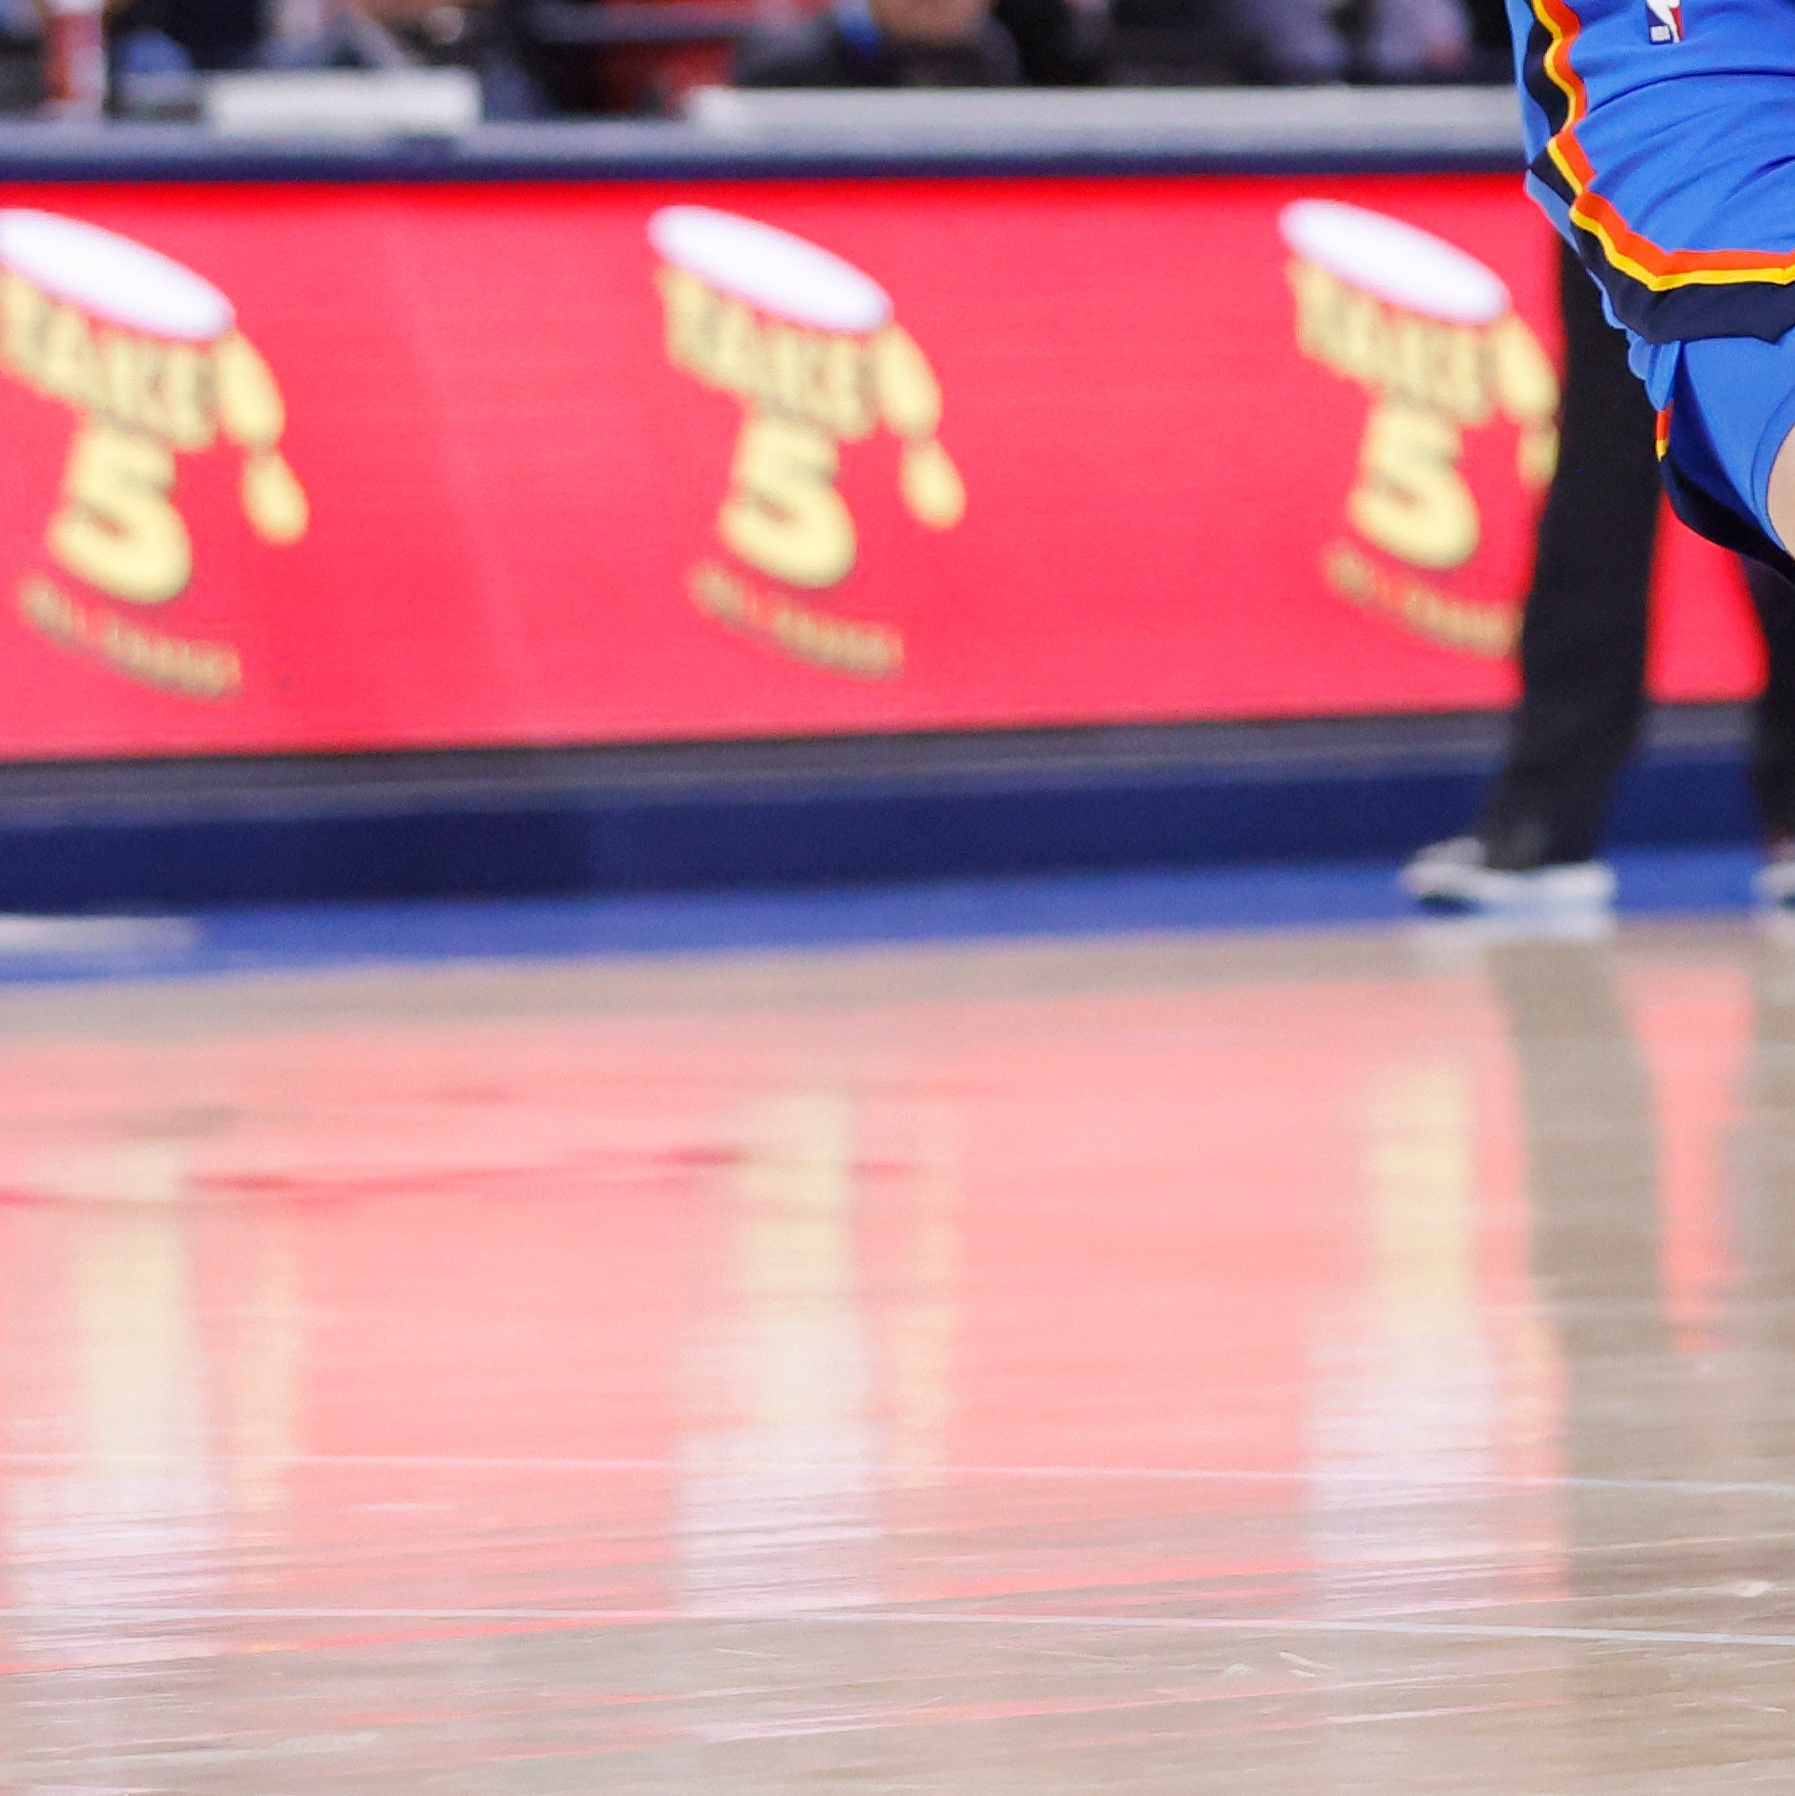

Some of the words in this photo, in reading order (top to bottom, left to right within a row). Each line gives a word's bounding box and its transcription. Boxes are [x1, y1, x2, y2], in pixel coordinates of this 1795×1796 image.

[45, 410, 194, 606] 5
[716, 401, 858, 590] 5
[1348, 396, 1481, 570] 5
